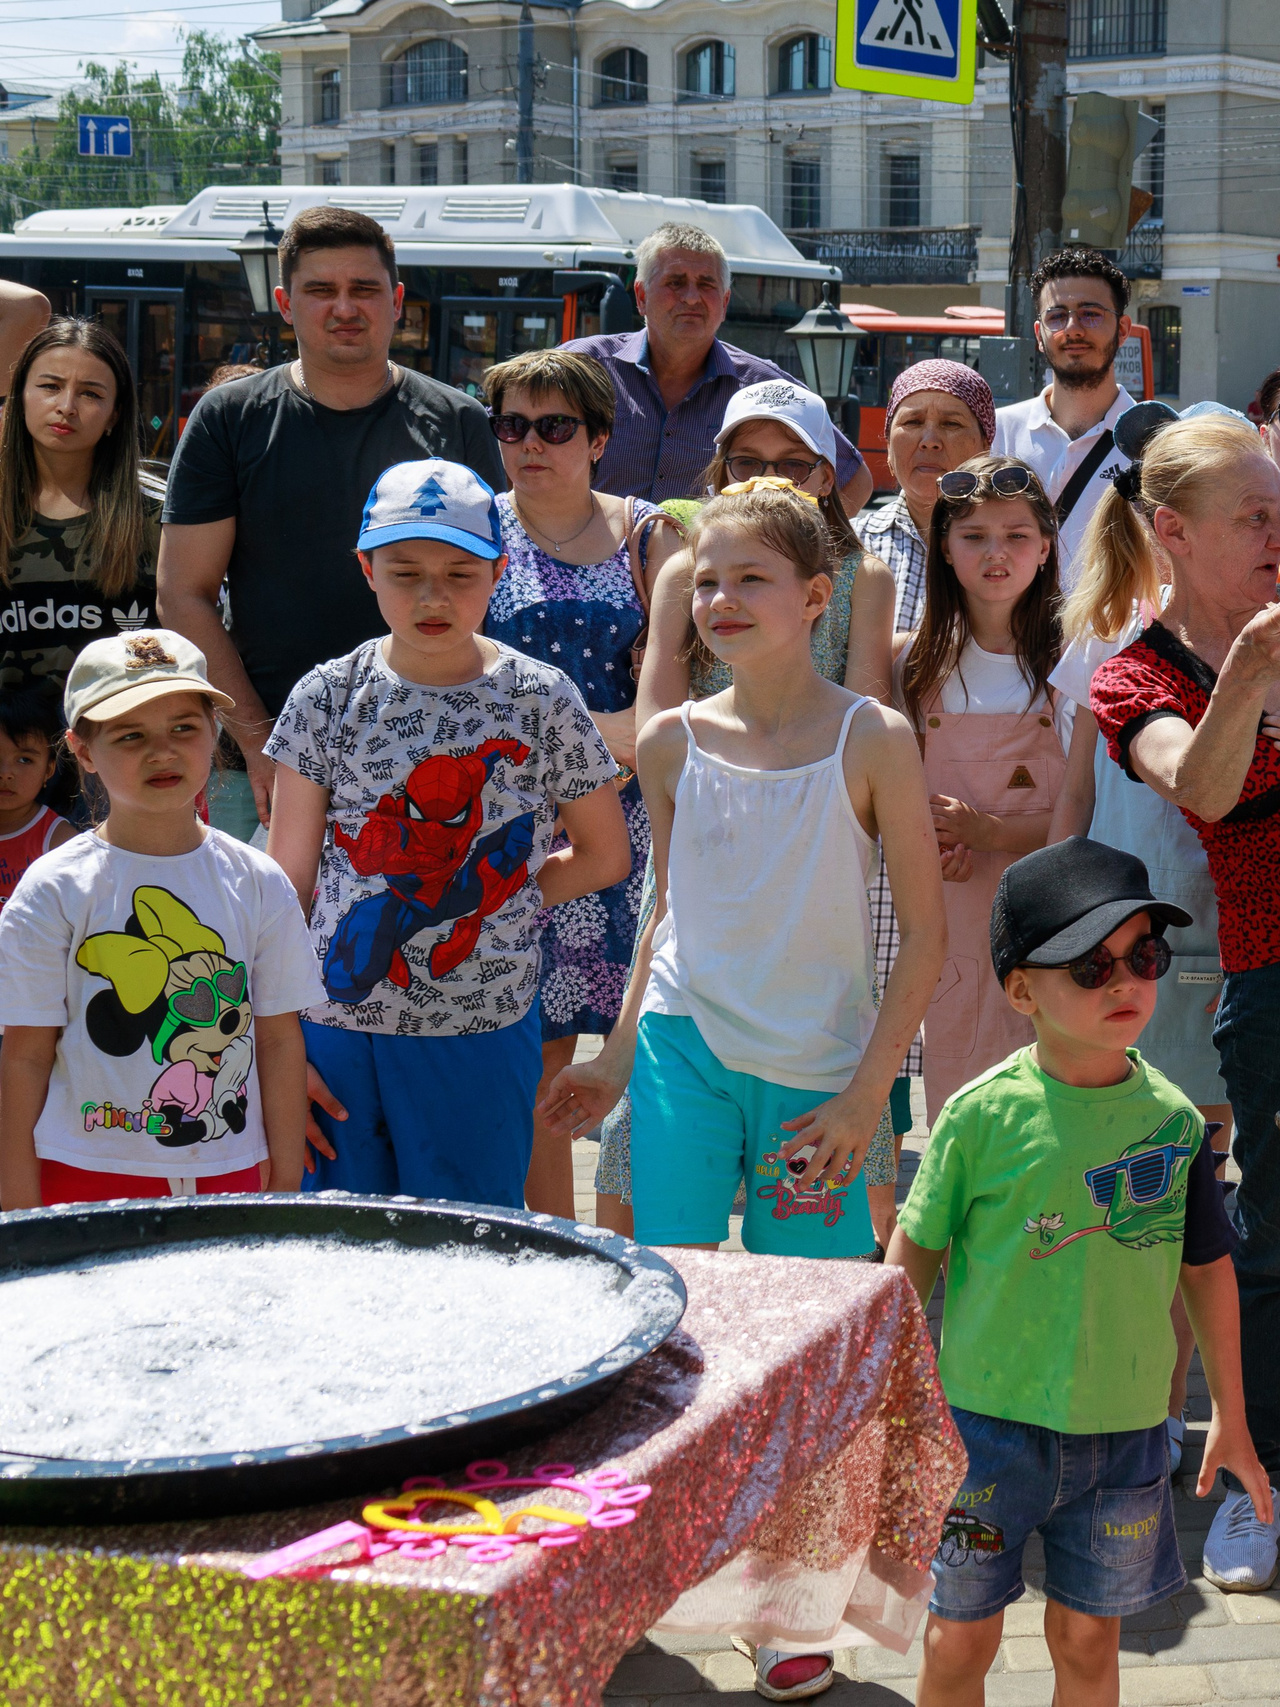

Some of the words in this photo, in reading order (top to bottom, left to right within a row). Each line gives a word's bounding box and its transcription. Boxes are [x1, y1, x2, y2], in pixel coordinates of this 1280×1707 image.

[498, 277, 518, 287] ВХОД
[1115, 346, 1140, 358] КТОР
[0, 598, 103, 634] didas
[515, 673, 539, 689] MAN
[504, 682, 550, 699] SPIDER-
[485, 702, 520, 713] SPIDER-
[384, 708, 432, 732] SPIDER-
[494, 712, 514, 723] MAN
[521, 714, 531, 735] MAN
[397, 724, 424, 742] MAN
[433, 711, 450, 746] SPIDER-
[446, 720, 460, 741] MAN
[361, 758, 399, 774] SPIDER-
[563, 752, 578, 771] MAN
[573, 741, 589, 775] SPIDER-
[372, 769, 394, 782] MAN
[471, 960, 518, 984] SPIDER-
[410, 975, 446, 1003] PIDER-
[451, 989, 491, 1006] SPIDER-
[400, 988, 429, 1009] MAN
[463, 1000, 486, 1013] MAN
[342, 1001, 392, 1016] SPIDER-
[356, 1014, 384, 1027] MAN
[410, 1016, 424, 1035] MAN
[756, 1164, 780, 1177] HELLO
[757, 1179, 848, 1227] Beauty
[955, 1483, 997, 1508] ppy
[1104, 1510, 1160, 1540] happy
